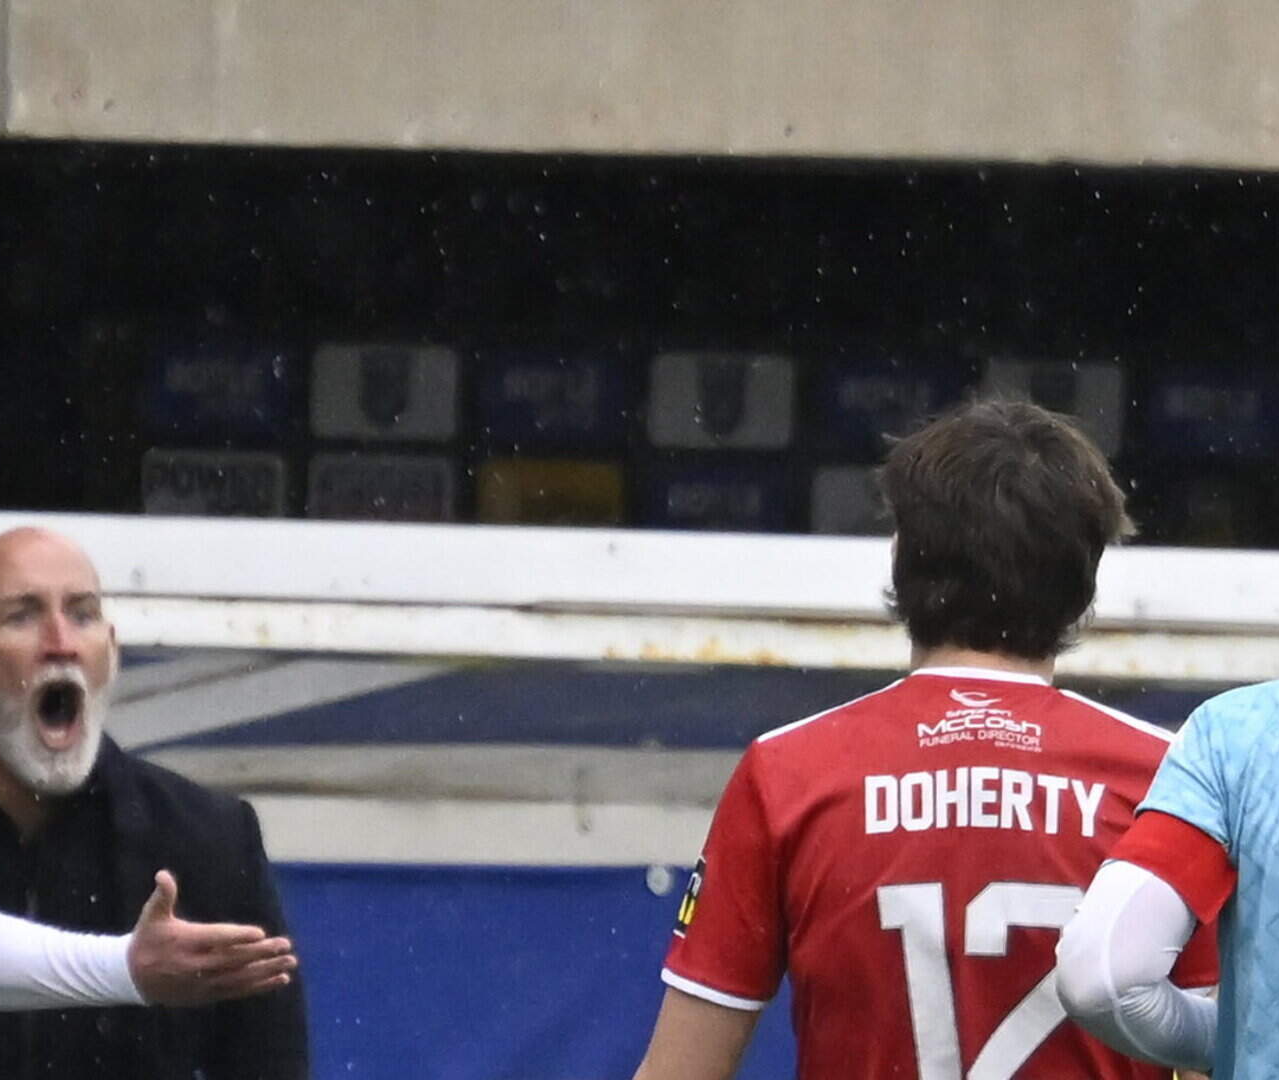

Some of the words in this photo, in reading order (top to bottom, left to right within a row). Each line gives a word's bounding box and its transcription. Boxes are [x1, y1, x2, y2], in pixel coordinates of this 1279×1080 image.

[919, 731, 975, 748] FUNERAL
[977, 729, 1040, 747] DIRECTOR
[864, 766, 1105, 837] DOHERTY
